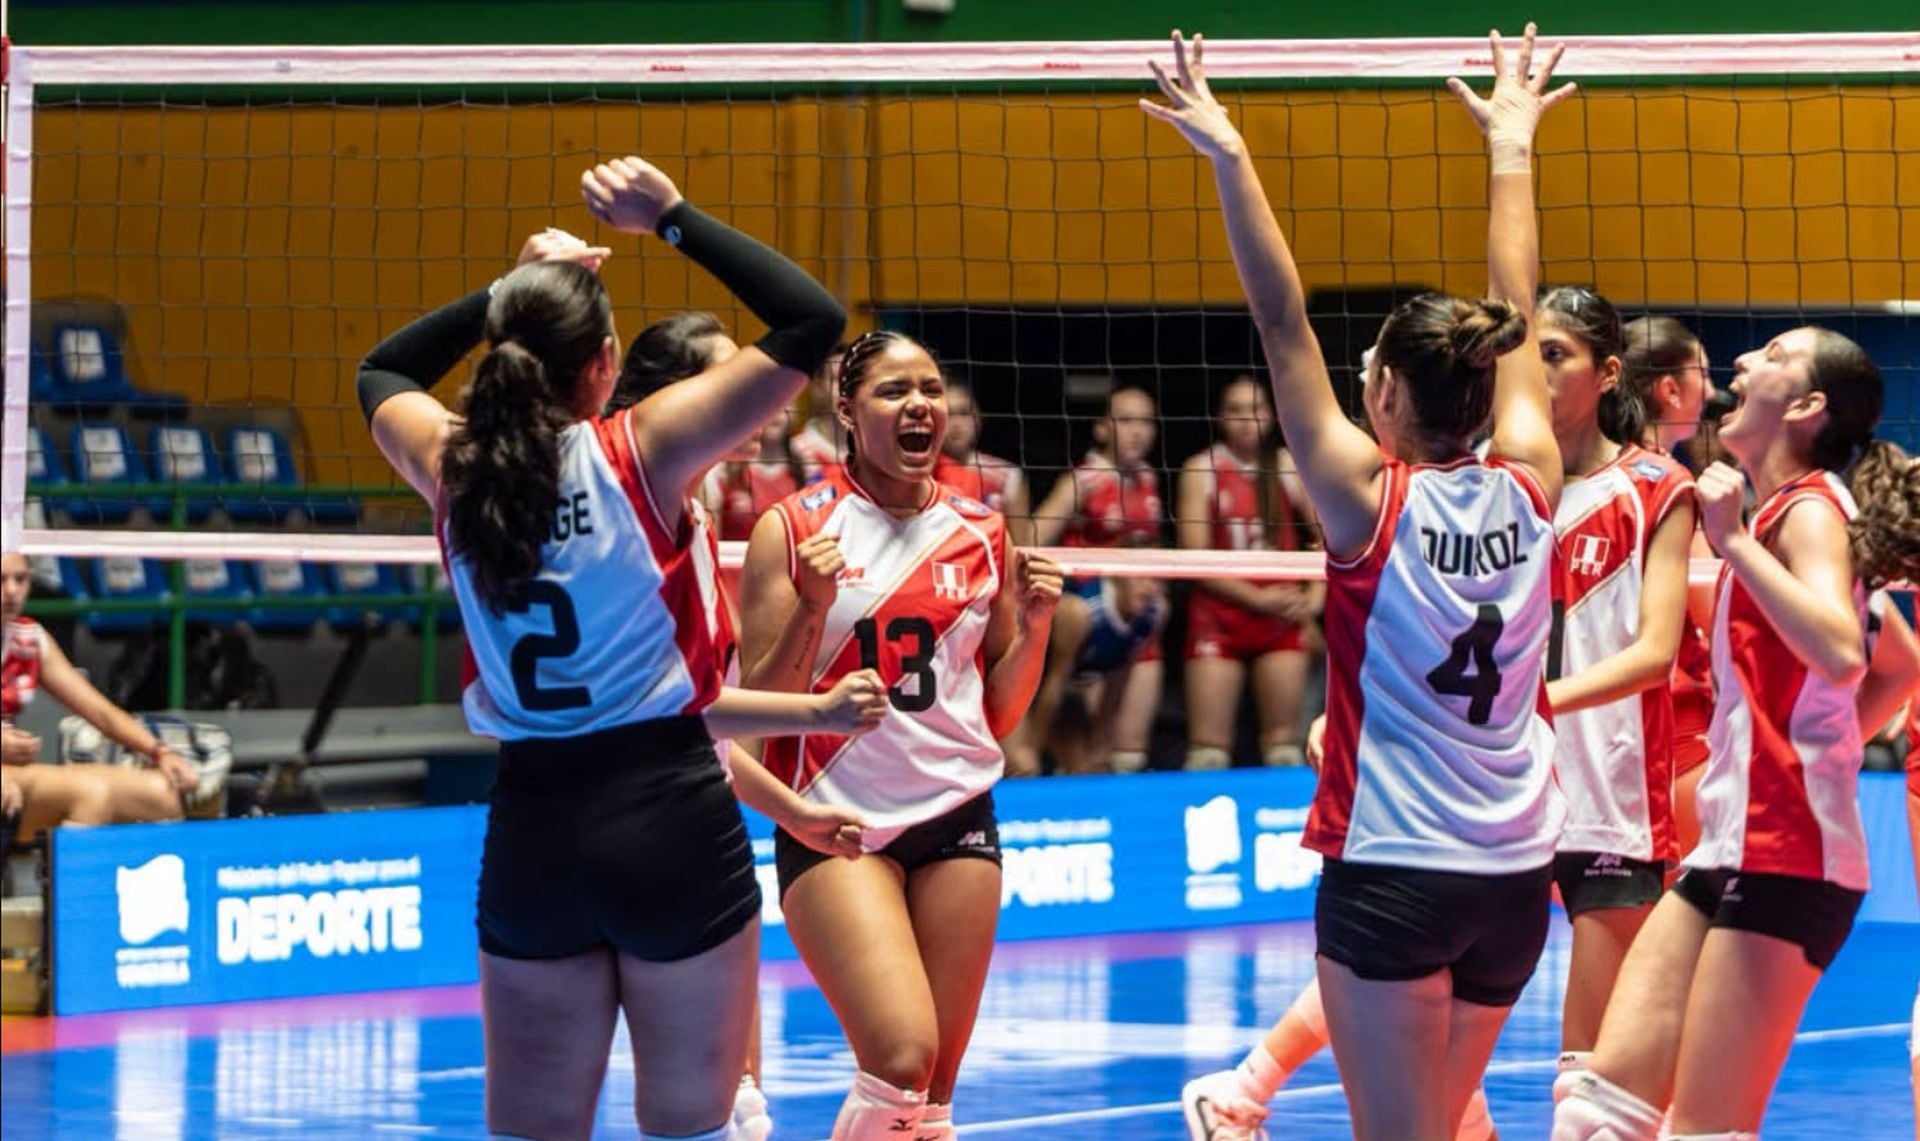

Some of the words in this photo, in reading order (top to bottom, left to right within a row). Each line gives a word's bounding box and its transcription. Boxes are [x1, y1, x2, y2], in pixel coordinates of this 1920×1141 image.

[935, 586, 967, 600] PER
[1570, 560, 1603, 577] PER
[510, 580, 592, 711] 2
[854, 617, 936, 712] 13
[1426, 604, 1504, 724] 4
[1001, 843, 1113, 907] PORTE
[216, 885, 422, 964] DEPORTE
